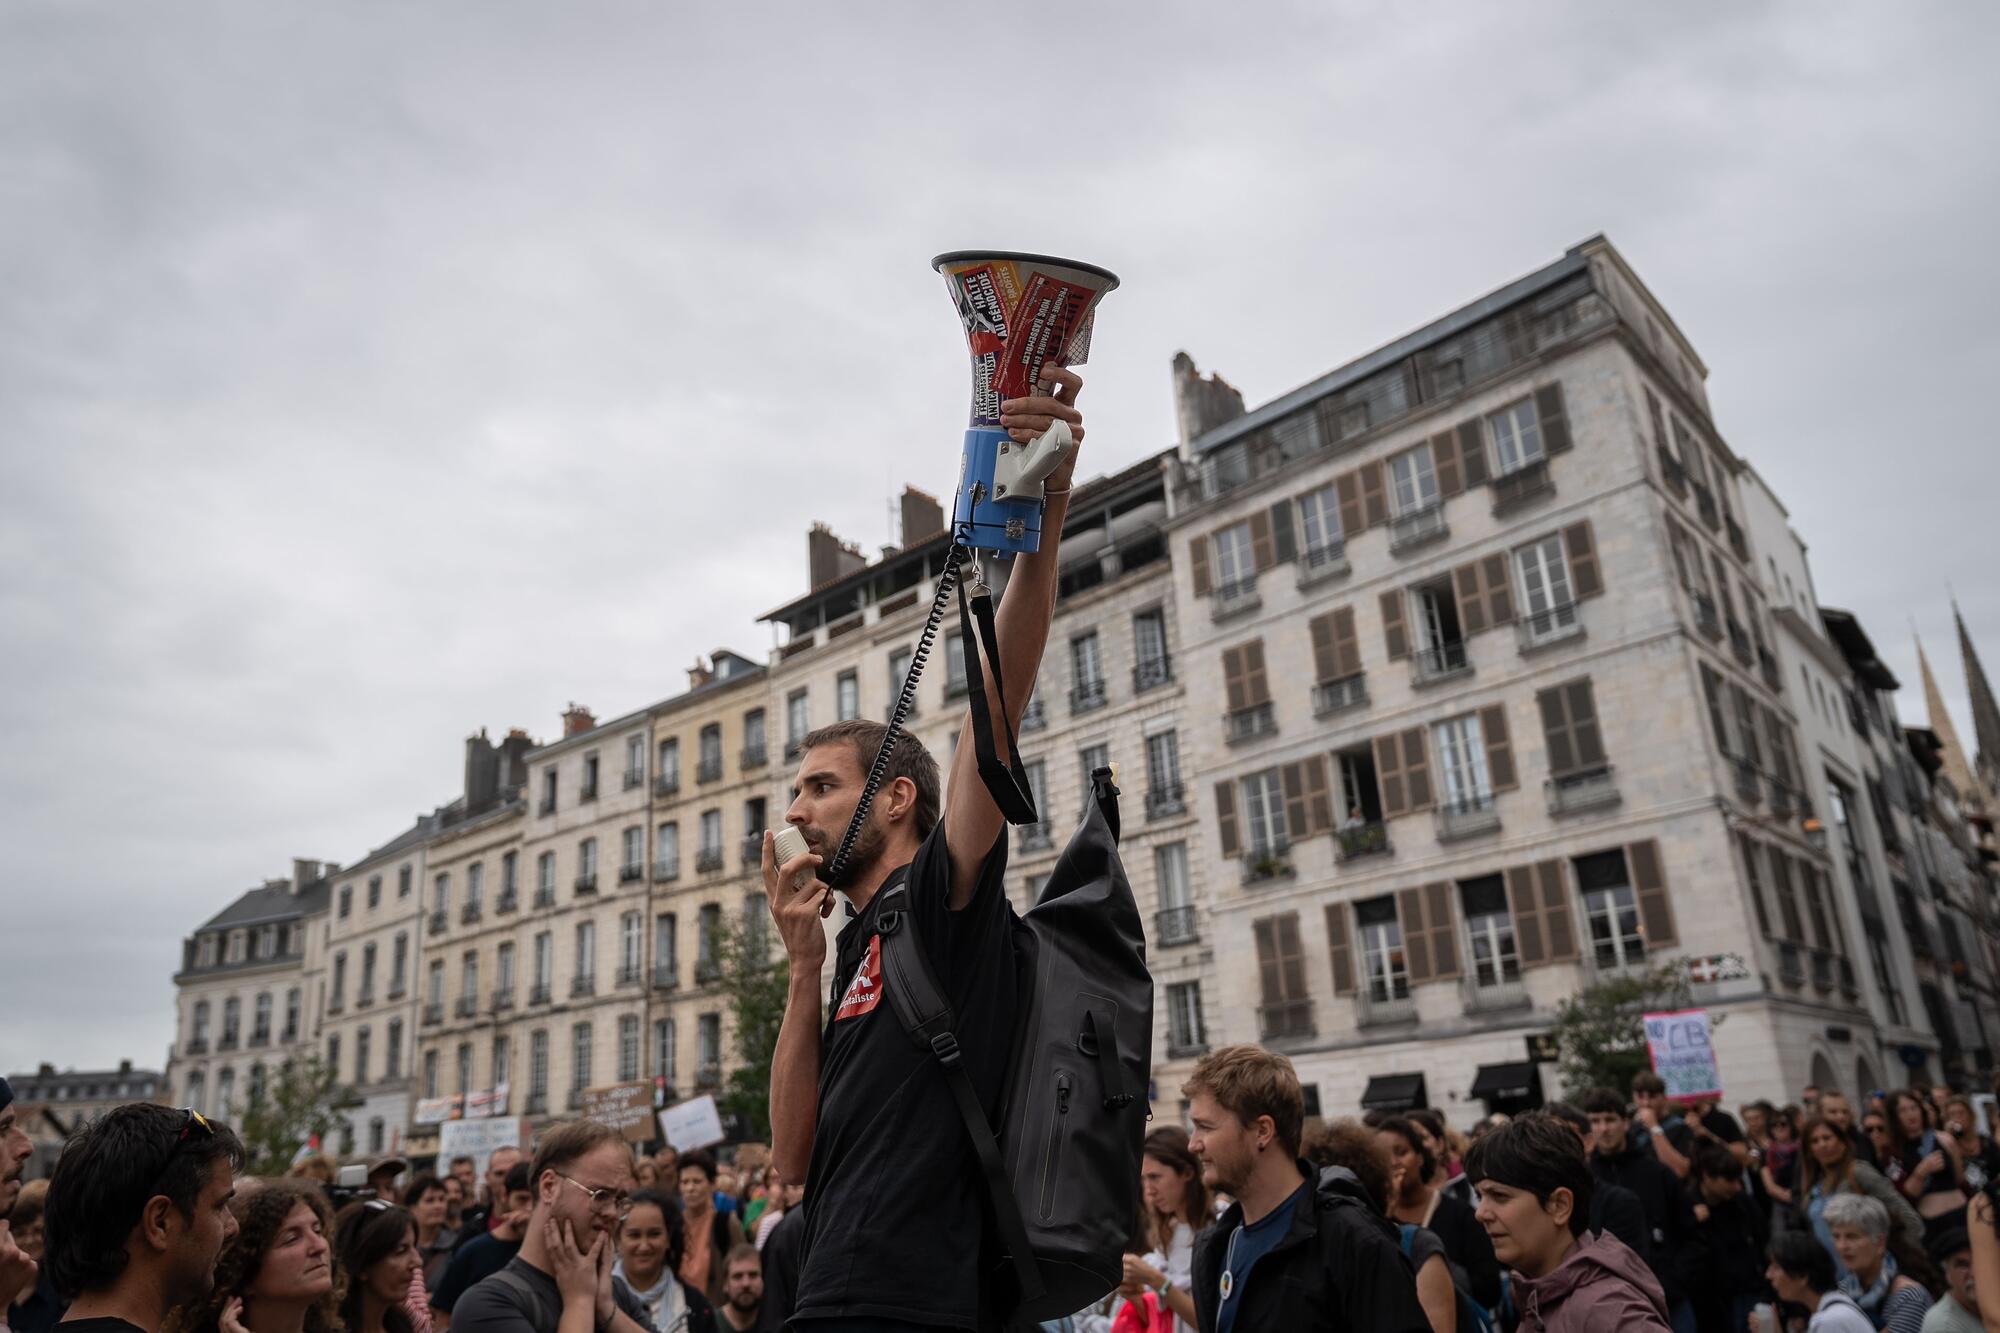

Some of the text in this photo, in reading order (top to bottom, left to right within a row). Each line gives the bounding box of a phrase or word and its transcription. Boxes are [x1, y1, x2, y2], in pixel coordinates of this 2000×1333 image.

[966, 276, 986, 309] HALTE
[1000, 266, 1018, 299] PROFITS
[977, 272, 1003, 322] GÉNOCIDE
[1038, 299, 1051, 318] NOUS
[995, 323, 1008, 337] AU
[1037, 327, 1051, 355] AFFAIRES
[1034, 355, 1042, 365] EN
[1029, 366, 1039, 383] MAIN
